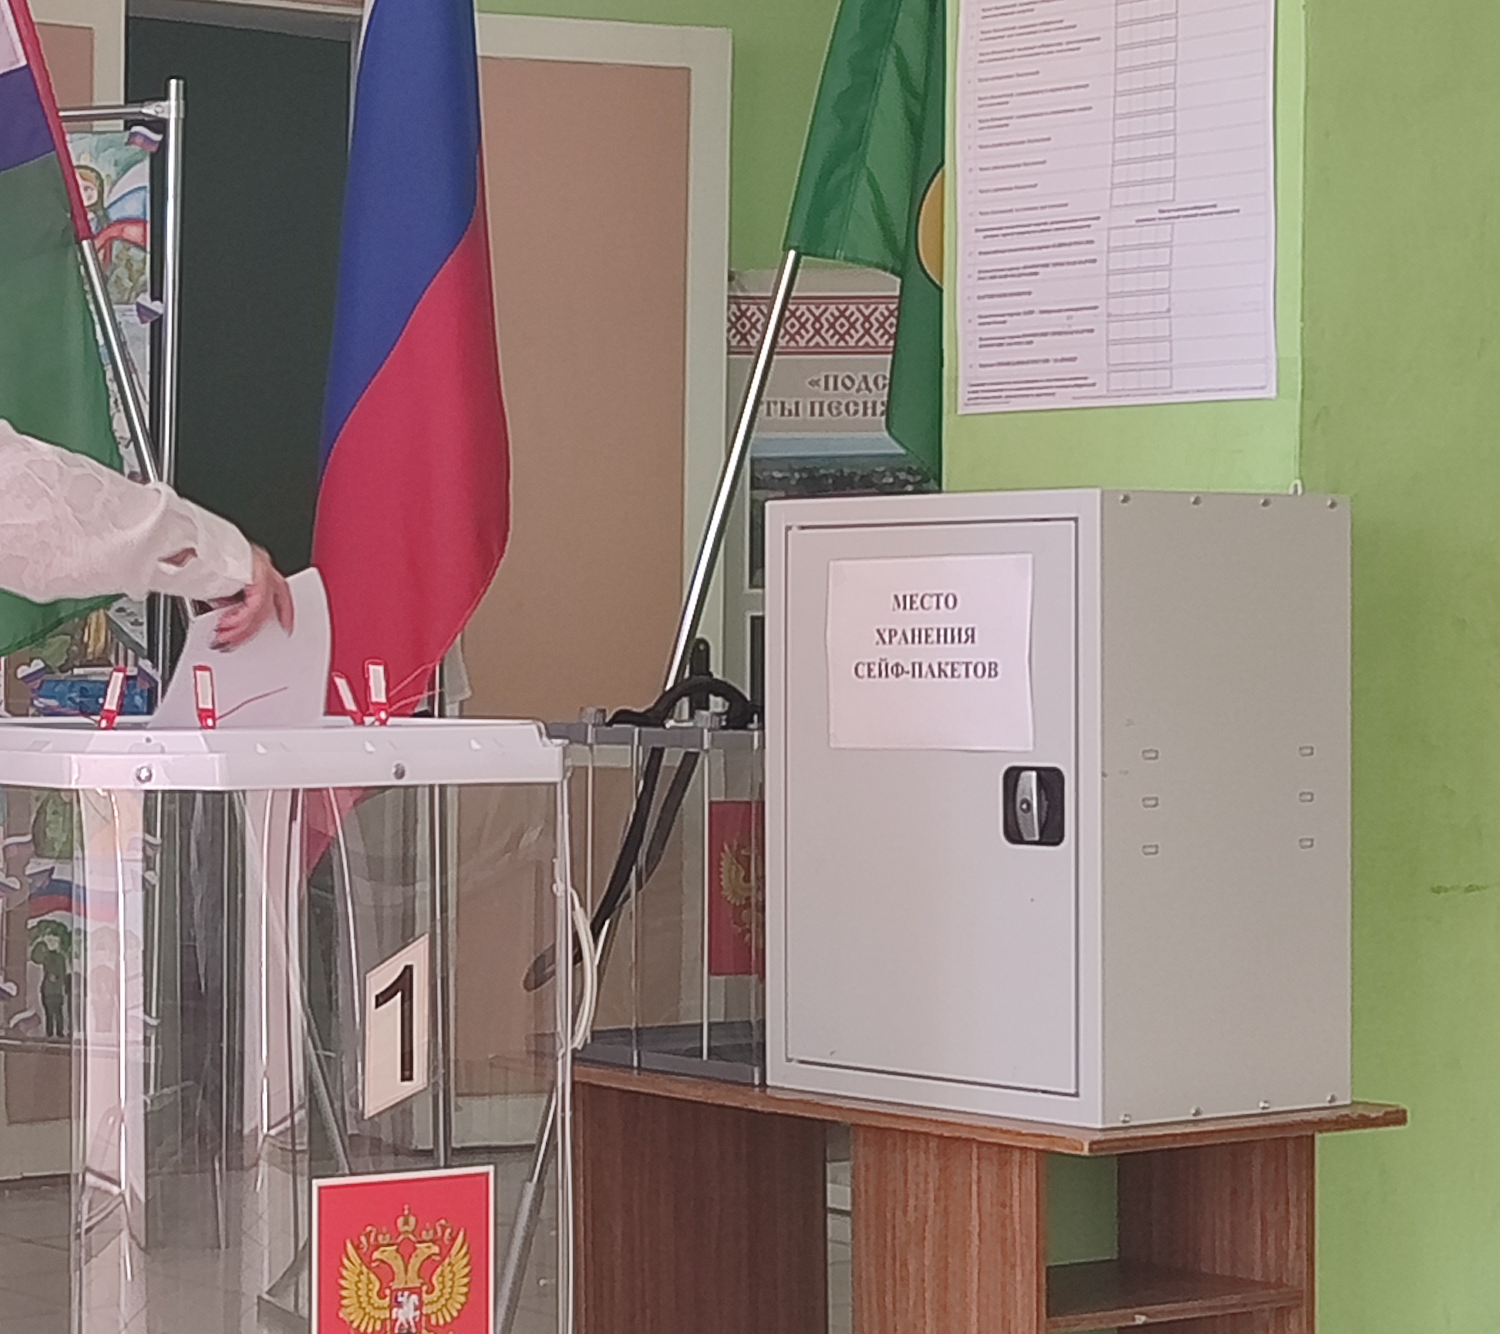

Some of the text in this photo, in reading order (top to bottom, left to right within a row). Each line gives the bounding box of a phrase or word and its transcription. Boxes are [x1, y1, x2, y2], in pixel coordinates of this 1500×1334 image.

[891, 592, 959, 612] МЕСТО
[874, 626, 977, 647] ХРАНЕНИЯ
[853, 657, 1000, 680] СЕЙФ-ПАКЕТОВ
[374, 963, 415, 1083] 1
